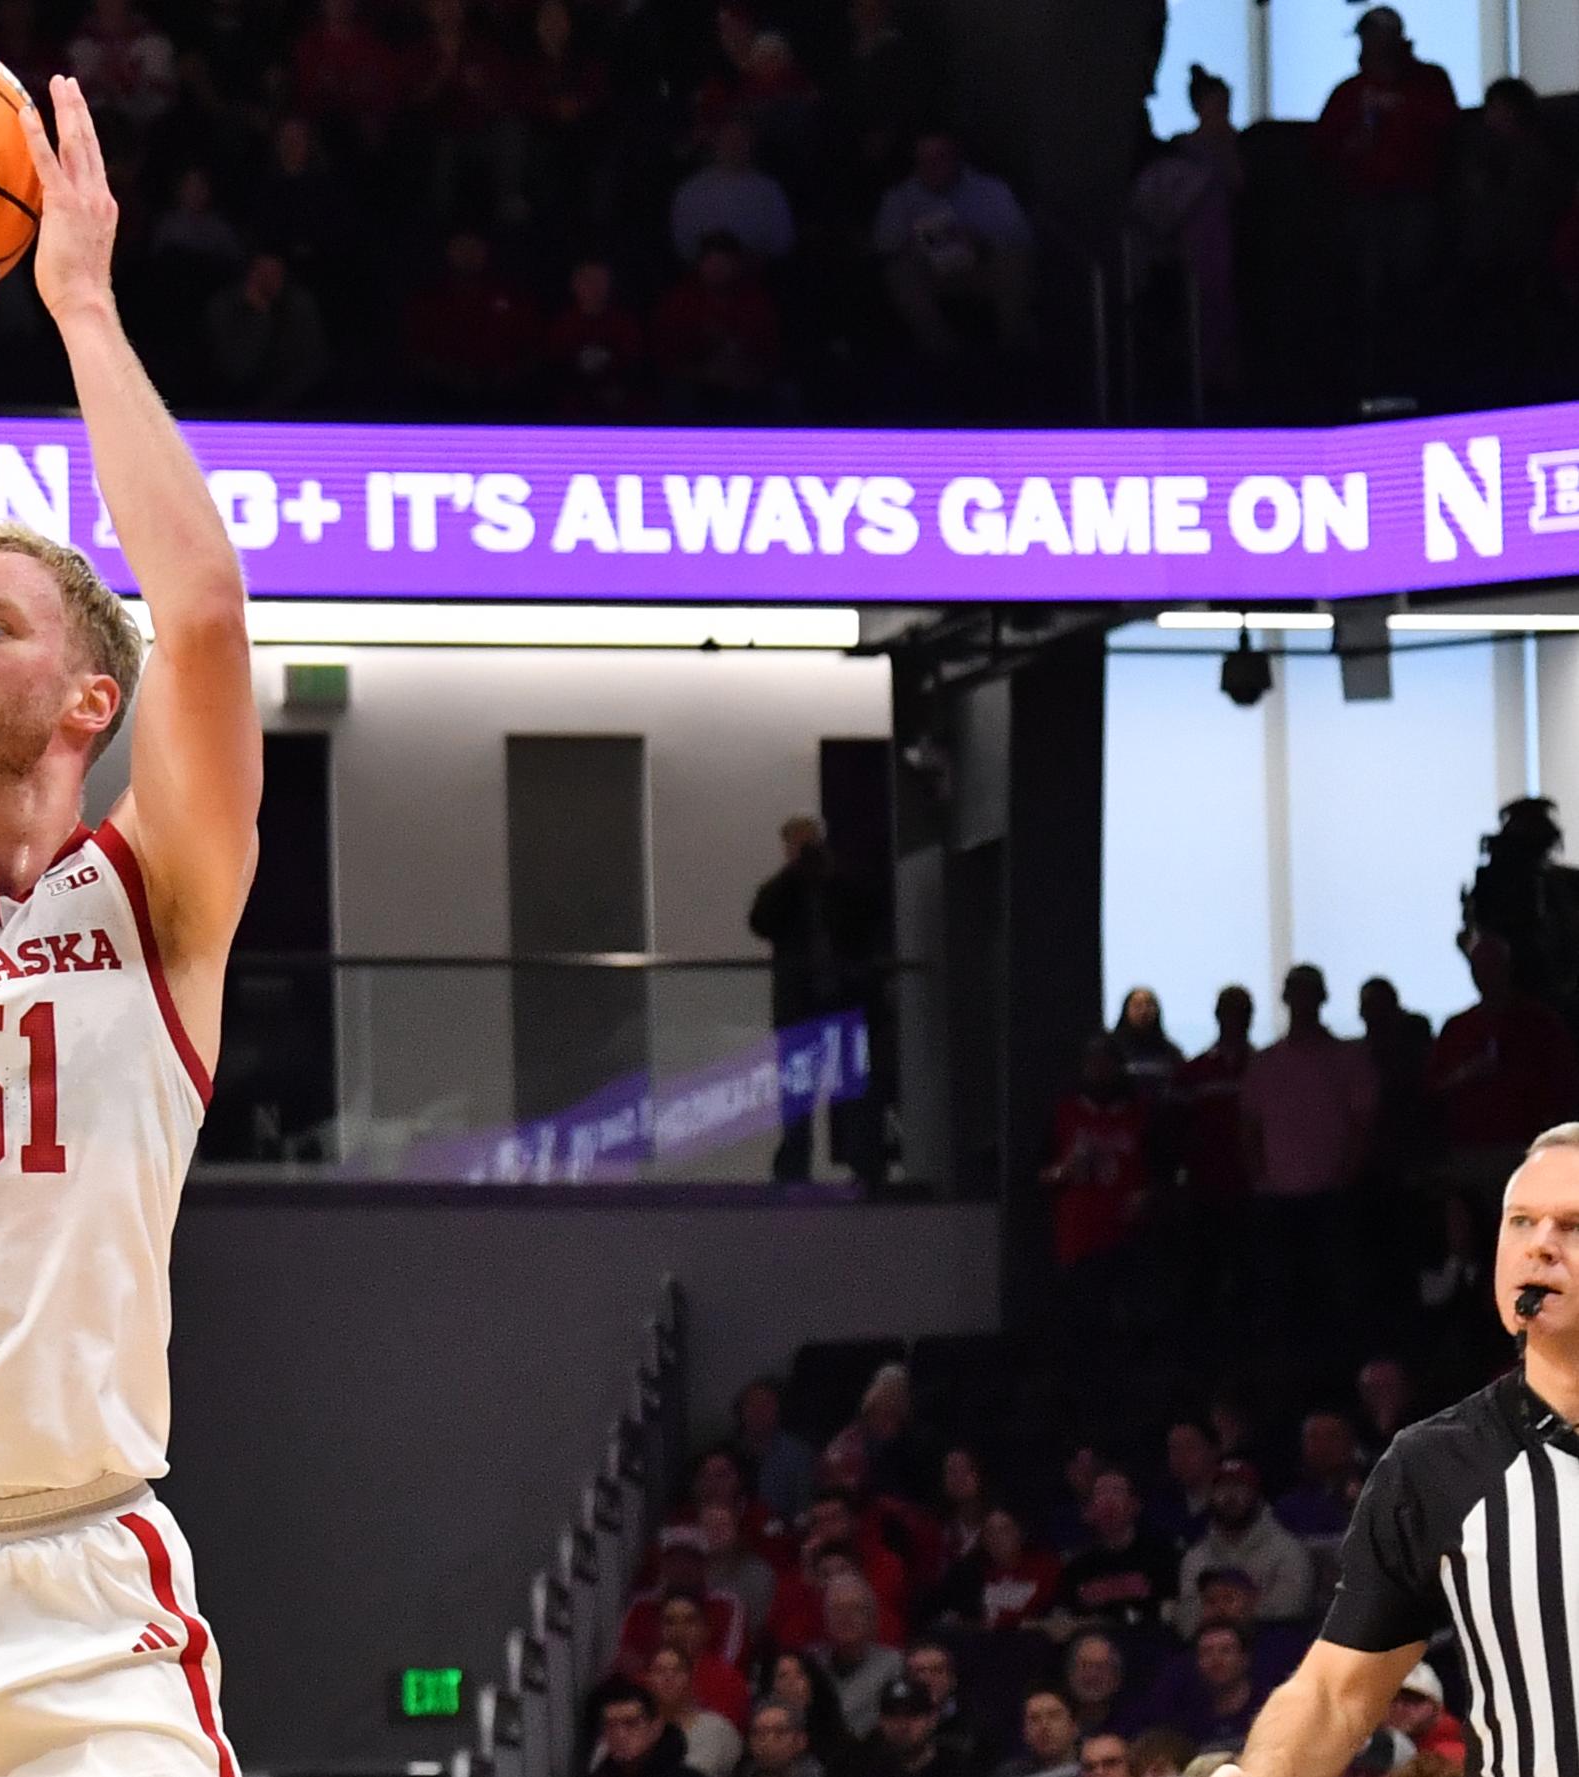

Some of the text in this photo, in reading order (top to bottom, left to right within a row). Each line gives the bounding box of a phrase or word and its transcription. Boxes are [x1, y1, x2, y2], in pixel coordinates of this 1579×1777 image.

[366, 471, 1370, 556] IT'S ALWAYS GAME ON
[1422, 435, 1503, 563] N
